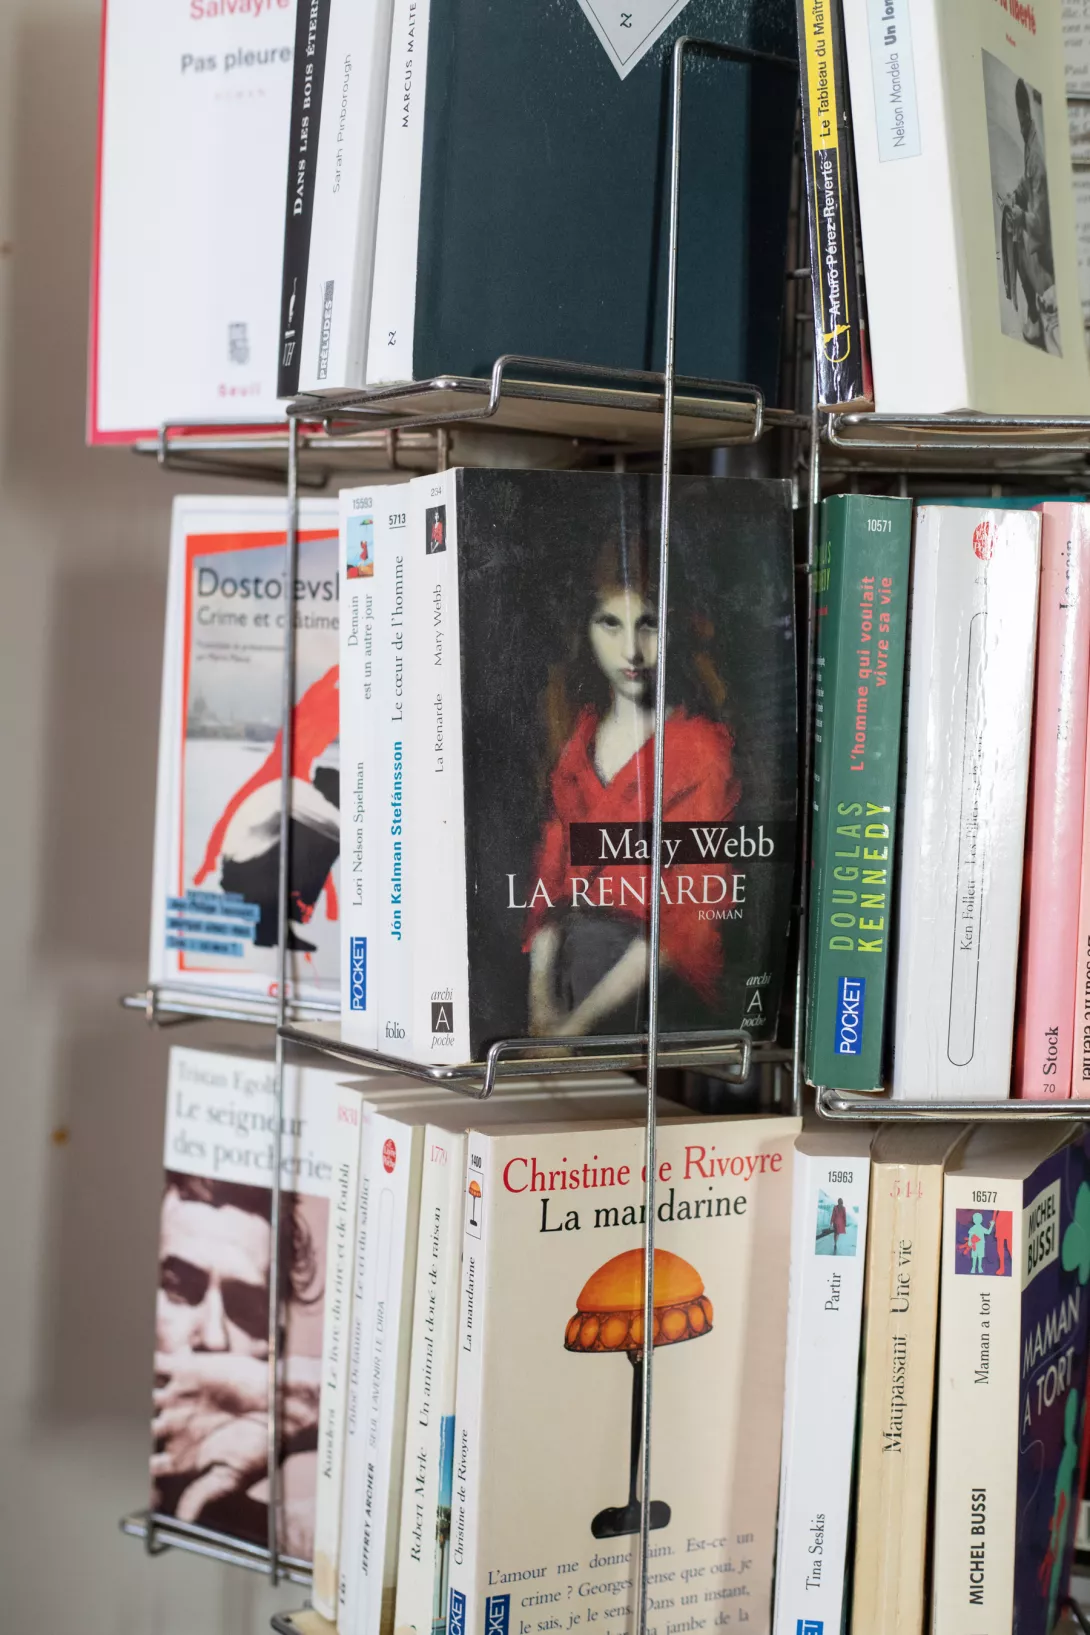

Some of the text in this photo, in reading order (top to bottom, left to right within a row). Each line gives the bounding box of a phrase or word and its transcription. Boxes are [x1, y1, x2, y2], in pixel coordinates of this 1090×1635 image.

[815, 39, 826, 57] du
[884, 25, 897, 46] Un
[181, 51, 217, 74] Pas
[402, 2, 416, 128] MARCUS MALTE
[885, 52, 901, 103] Mandela
[817, 61, 829, 116] Tableau
[293, 63, 313, 216] DANS LES BOIS
[333, 54, 352, 193] Sarah Pinborough
[820, 120, 830, 137] Le
[893, 107, 906, 147] Nelson
[829, 271, 840, 315] Arturo
[389, 513, 406, 525] 5713
[867, 519, 892, 533] 10571
[197, 606, 247, 627] Crime
[253, 611, 270, 628] et
[347, 595, 359, 647] Demain
[362, 593, 375, 620] jour
[433, 584, 445, 666] Mary Webb
[392, 555, 403, 721] Le cœur de l'homme
[874, 577, 893, 688] vivre sa vie
[365, 661, 372, 678] un
[850, 576, 875, 771] L'homme qui voulait
[434, 693, 443, 773] La Renarde
[353, 761, 364, 906] Lori Nelson Spielman
[391, 741, 402, 941] Jón Kalman Stefánsson
[598, 825, 775, 868] May Webb
[505, 873, 555, 909] LA
[829, 802, 863, 951] DOUGLAS
[857, 802, 891, 953] KENNEDY
[698, 909, 743, 921] ROMAN
[960, 925, 973, 951] Ken
[353, 938, 364, 1009] POCKET
[435, 1006, 450, 1030] A
[747, 990, 763, 1013] A
[839, 976, 861, 1054] POCKET
[385, 1021, 405, 1039] folio
[1043, 1025, 1059, 1075] Stock
[1043, 1084, 1056, 1093] 70
[502, 1155, 630, 1193] Christine
[683, 1145, 783, 1181] Rivoyre
[827, 1170, 853, 1184] 15963
[540, 1198, 581, 1232] La
[972, 1191, 998, 1203] 16577
[1028, 1194, 1056, 1238] MICHEL
[430, 1206, 441, 1258] raison
[1027, 1223, 1055, 1276] BUSSI
[428, 1264, 438, 1285] de
[824, 1272, 842, 1311] Partir
[376, 1301, 385, 1332] DIRA
[463, 1256, 475, 1352] La mandarine
[882, 1239, 912, 1453] Maupassant Une vie
[974, 1291, 991, 1385] Maman a tort
[1022, 1286, 1080, 1379] MAMAN
[423, 1336, 435, 1397] animal
[1022, 1346, 1074, 1435] A TORT
[419, 1402, 430, 1427] Un
[365, 1463, 375, 1518] ARCHER
[410, 1447, 427, 1562] Robert Merle
[455, 1429, 469, 1566] Christine de Rivoyre
[361, 1521, 371, 1576] JEFFREY
[487, 1533, 754, 1585] L'amour me donne Est-ce un
[806, 1513, 825, 1590] Tina Seskis
[969, 1488, 986, 1605] MICHEL BUSSI
[521, 1591, 562, 1608] crime
[567, 1585, 573, 1599] ?
[578, 1577, 633, 1595] Georges
[680, 1567, 706, 1583] que
[738, 1559, 752, 1574] je
[519, 1620, 531, 1634] le
[537, 1615, 562, 1631] sais,
[566, 1612, 581, 1630] je
[587, 1608, 598, 1622] le
[681, 1594, 698, 1606] un
[714, 1611, 730, 1626] de
[738, 1607, 749, 1622] la
